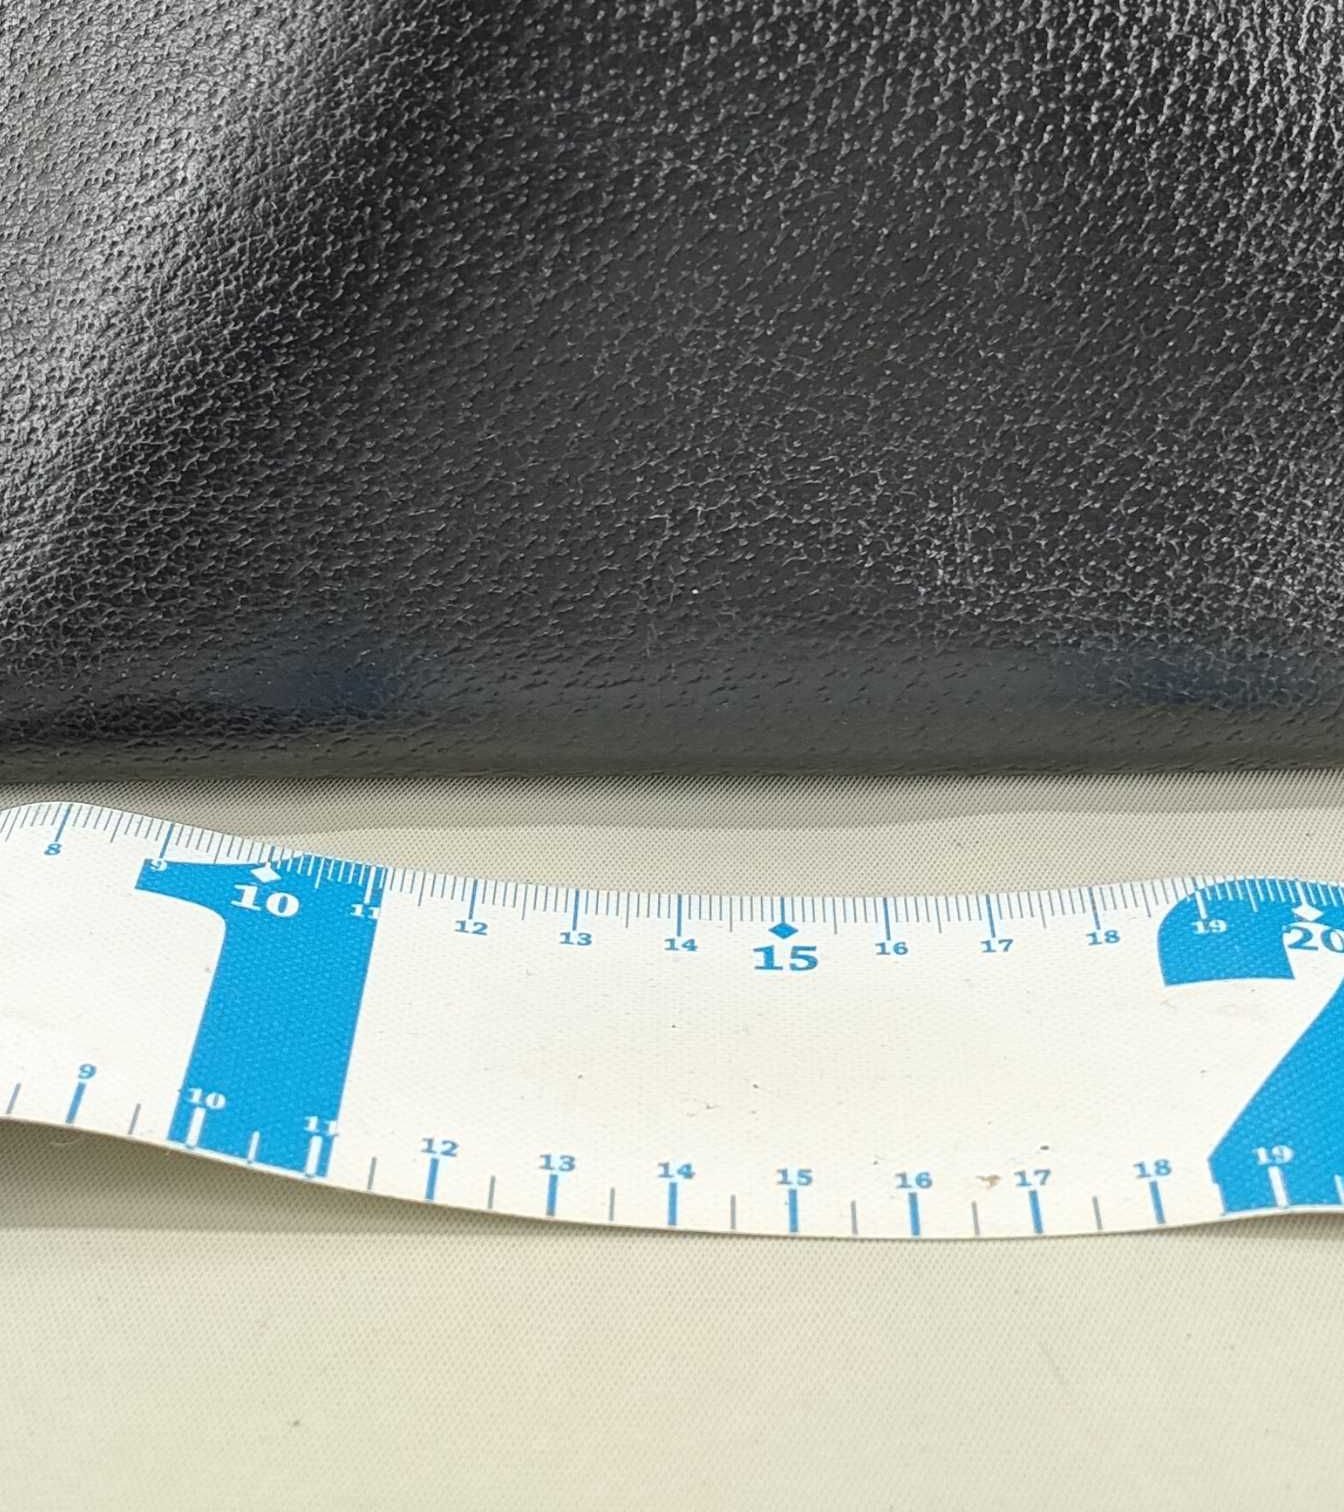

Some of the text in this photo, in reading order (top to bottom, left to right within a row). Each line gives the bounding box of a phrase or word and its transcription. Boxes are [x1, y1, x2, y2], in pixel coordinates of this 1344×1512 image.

[44, 843, 62, 857] 8
[230, 883, 301, 918] 10
[453, 919, 488, 936] 12
[559, 931, 592, 946] 13
[663, 937, 698, 952] 14
[752, 944, 819, 973] 15
[874, 941, 909, 957] 16
[981, 938, 1014, 954] 17
[1087, 930, 1120, 946] 18
[1191, 918, 1227, 936] 19
[135, 854, 387, 1179] 1
[77, 1064, 96, 1080] 9
[186, 1089, 227, 1111] 10
[420, 1138, 459, 1157] 12
[538, 1154, 576, 1172] 13
[657, 1162, 695, 1180] 14
[776, 1169, 814, 1186] 15
[894, 1172, 933, 1190] 16
[1013, 1169, 1052, 1187] 17
[1132, 1159, 1173, 1178] 18
[1253, 1145, 1295, 1165] 19
